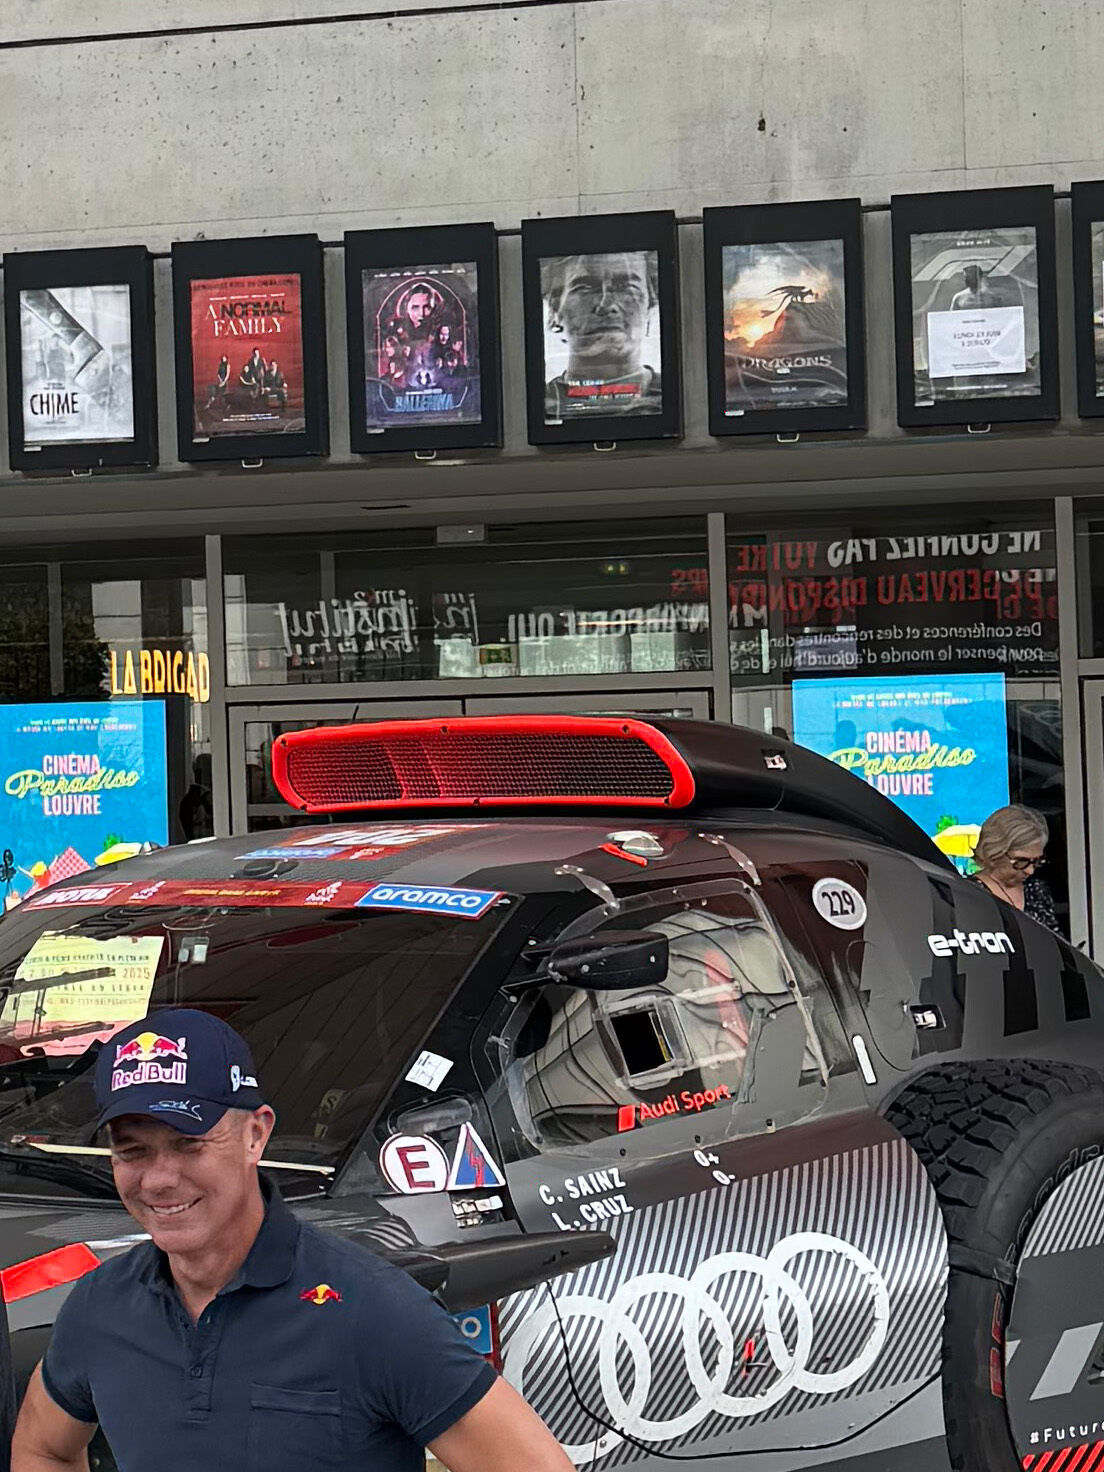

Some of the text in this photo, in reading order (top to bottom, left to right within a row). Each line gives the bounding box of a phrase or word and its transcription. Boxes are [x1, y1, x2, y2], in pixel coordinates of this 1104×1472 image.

[214, 317, 286, 337] FAMILY
[29, 391, 80, 418] CHIME
[110, 649, 211, 703] LA BRIGAD
[866, 728, 932, 754] CINÉMA
[42, 752, 101, 776] CINÉMA
[826, 742, 976, 777] Paradiso
[4, 767, 141, 799] Paradiso
[43, 794, 103, 816] LOUVRE
[372, 886, 482, 909] aramco
[821, 889, 856, 917] 229
[927, 927, 1016, 958] e-tron
[111, 1061, 187, 1092] Red Bull
[640, 1083, 732, 1121] Audi Sport
[395, 1144, 436, 1190] E
[538, 1167, 626, 1206] C. SAINZ
[550, 1194, 635, 1232] L. CRUZ
